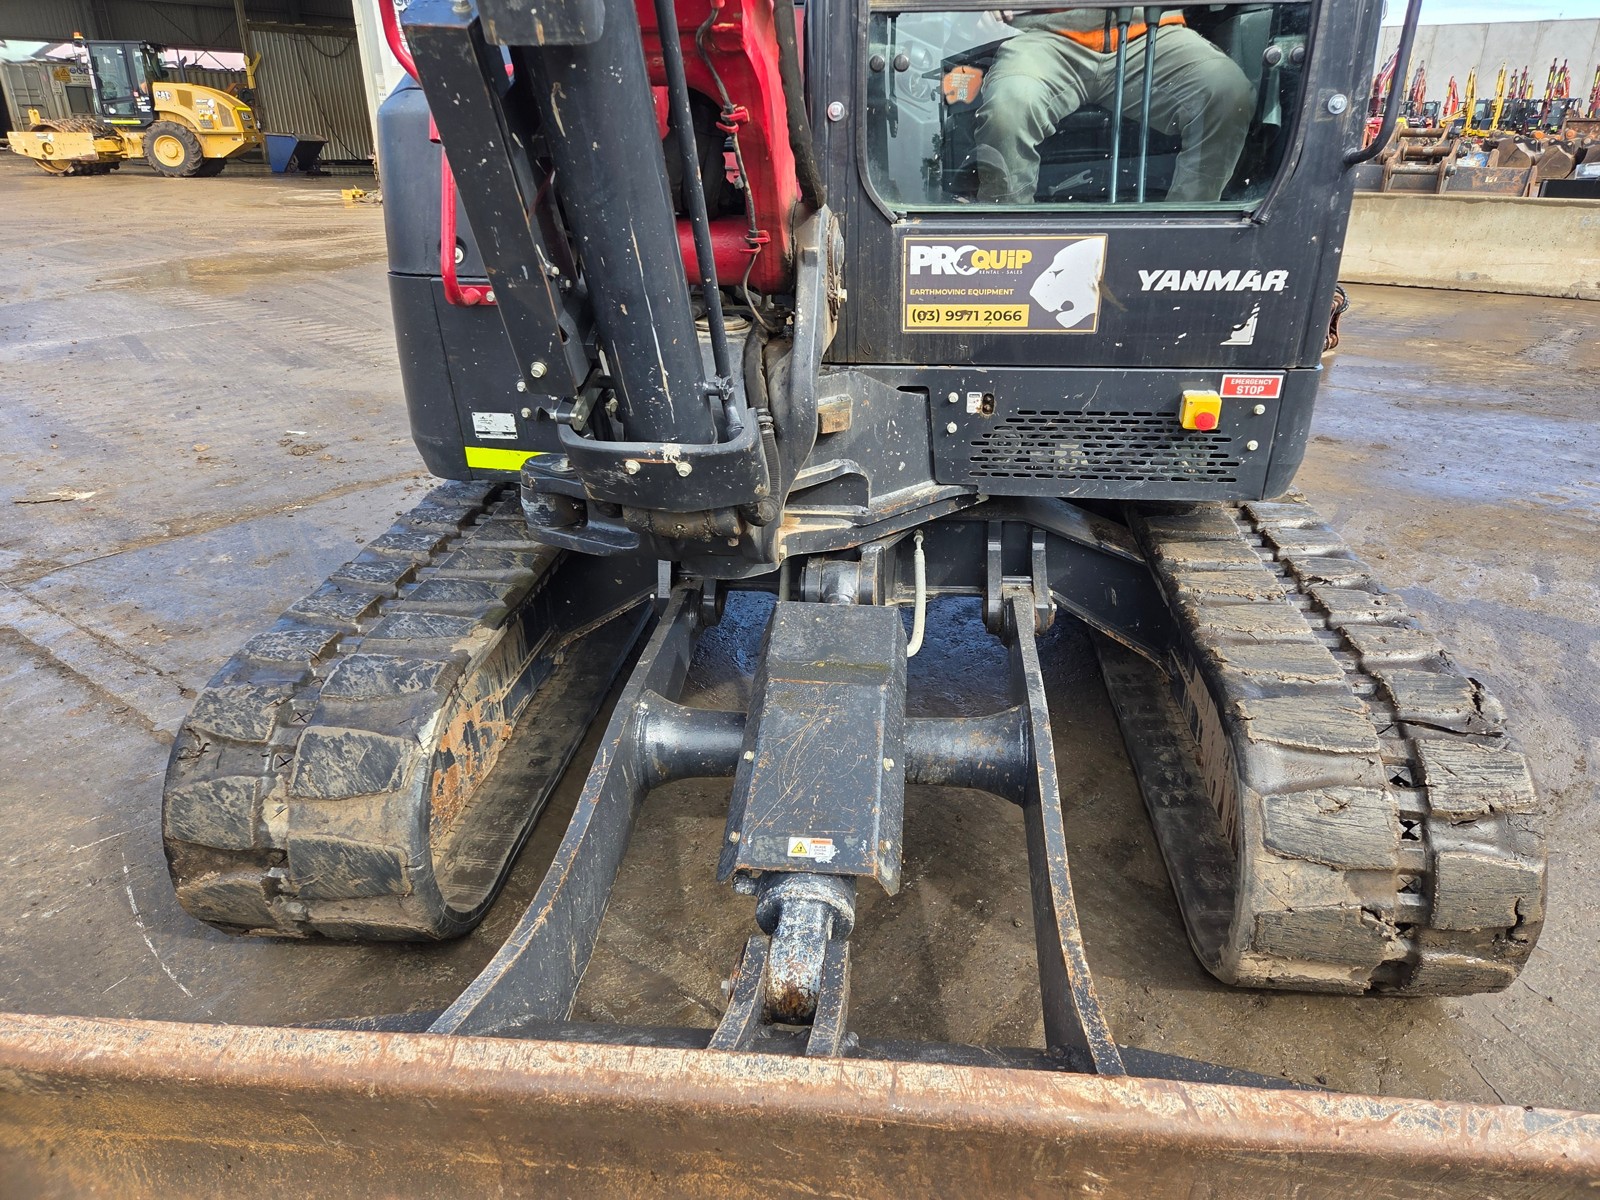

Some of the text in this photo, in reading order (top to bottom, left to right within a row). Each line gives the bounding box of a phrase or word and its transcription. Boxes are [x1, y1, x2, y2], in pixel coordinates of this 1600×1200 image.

[1138, 269, 1289, 291] YANMAR
[910, 288, 1015, 296] EARTHMOVING EQUIPMENT
[912, 308, 1022, 323] (03) 9971 2066
[1236, 385, 1265, 395] STOP
